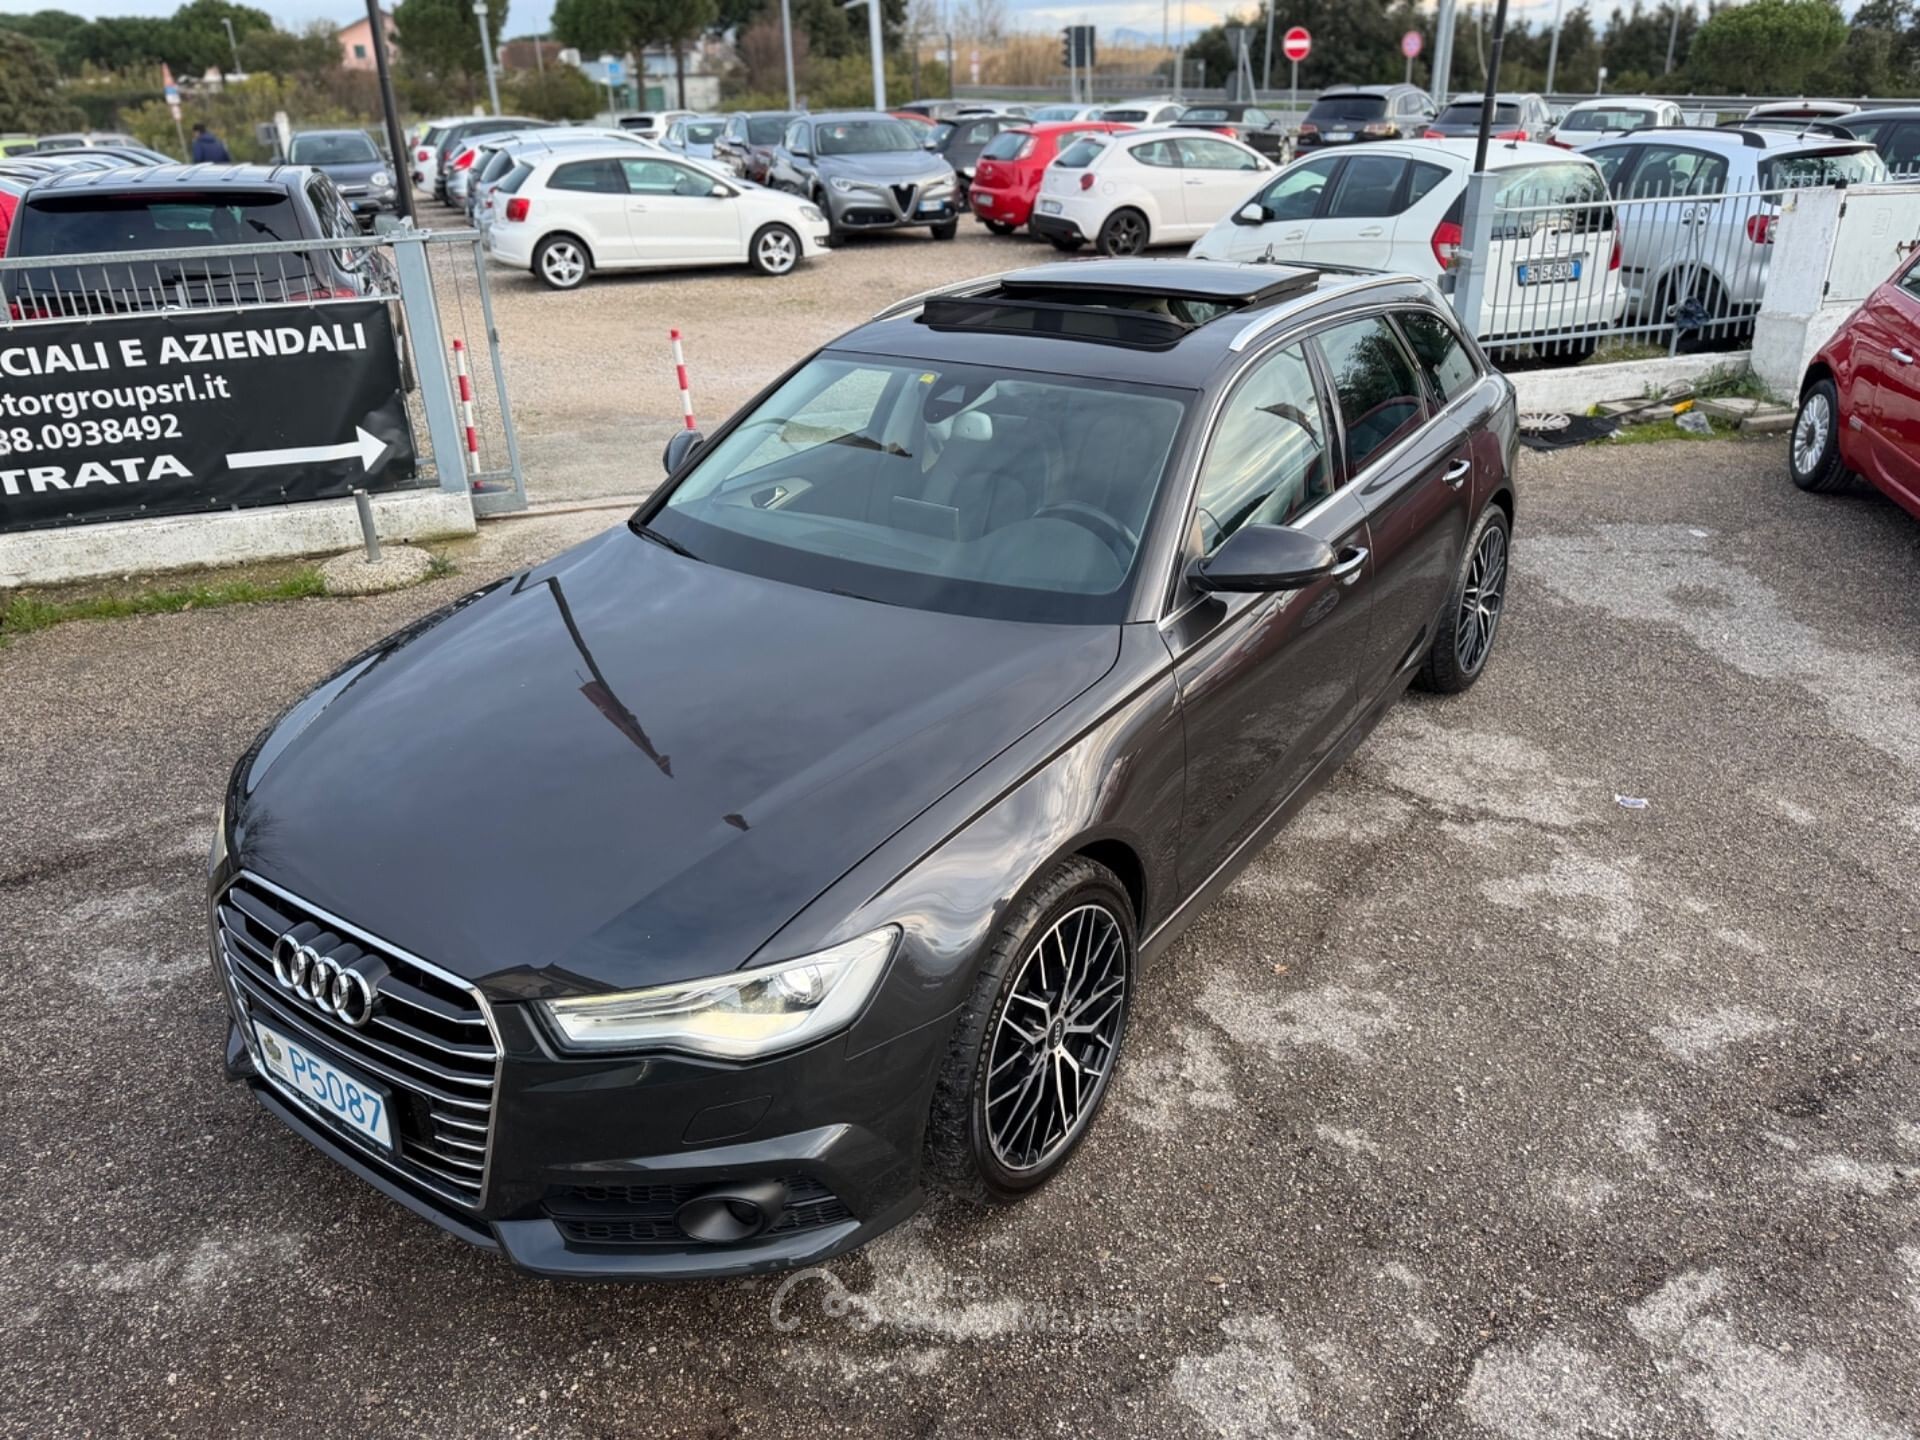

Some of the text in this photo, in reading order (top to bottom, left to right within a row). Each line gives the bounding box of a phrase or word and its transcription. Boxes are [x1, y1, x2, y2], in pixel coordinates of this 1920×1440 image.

[0, 322, 367, 377] CIALI E AZIENDALI
[0, 373, 231, 418] torgroupsrl.it
[0, 454, 194, 495] TRATA
[288, 1046, 383, 1133] P5087
